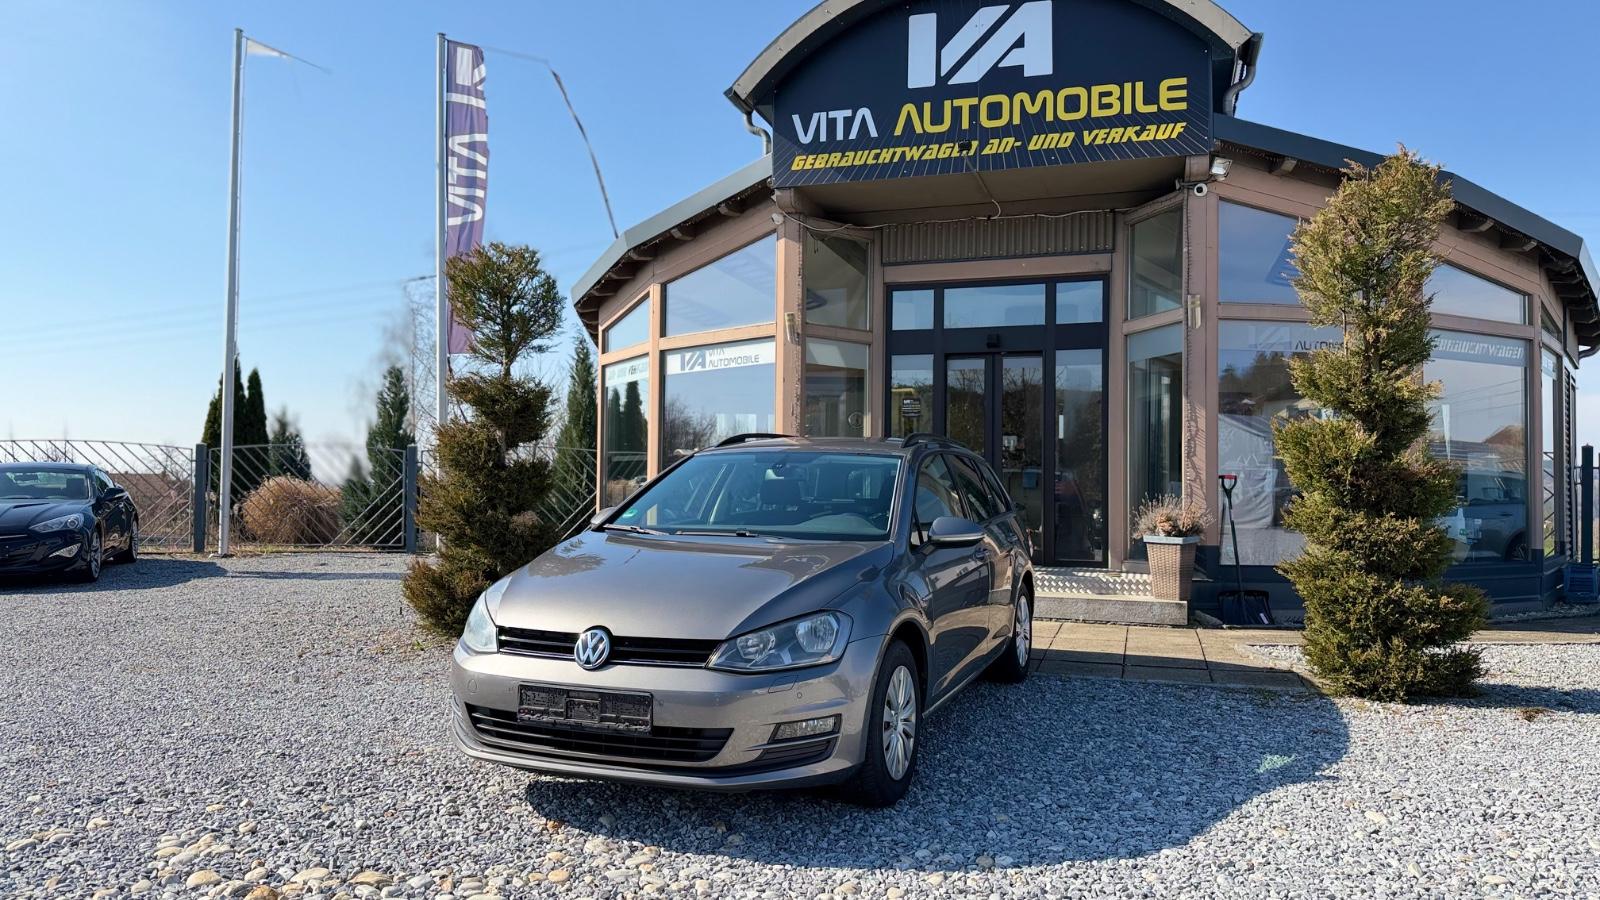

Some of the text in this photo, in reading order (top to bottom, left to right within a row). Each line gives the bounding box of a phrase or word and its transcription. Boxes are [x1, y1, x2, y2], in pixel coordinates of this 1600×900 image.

[791, 77, 1188, 144] VITA AUTOMOBILE
[1027, 132, 1076, 151] UND
[1083, 122, 1187, 146] VERKAUF
[447, 133, 489, 226] VITA
[708, 354, 760, 368] AUTOMOBILE
